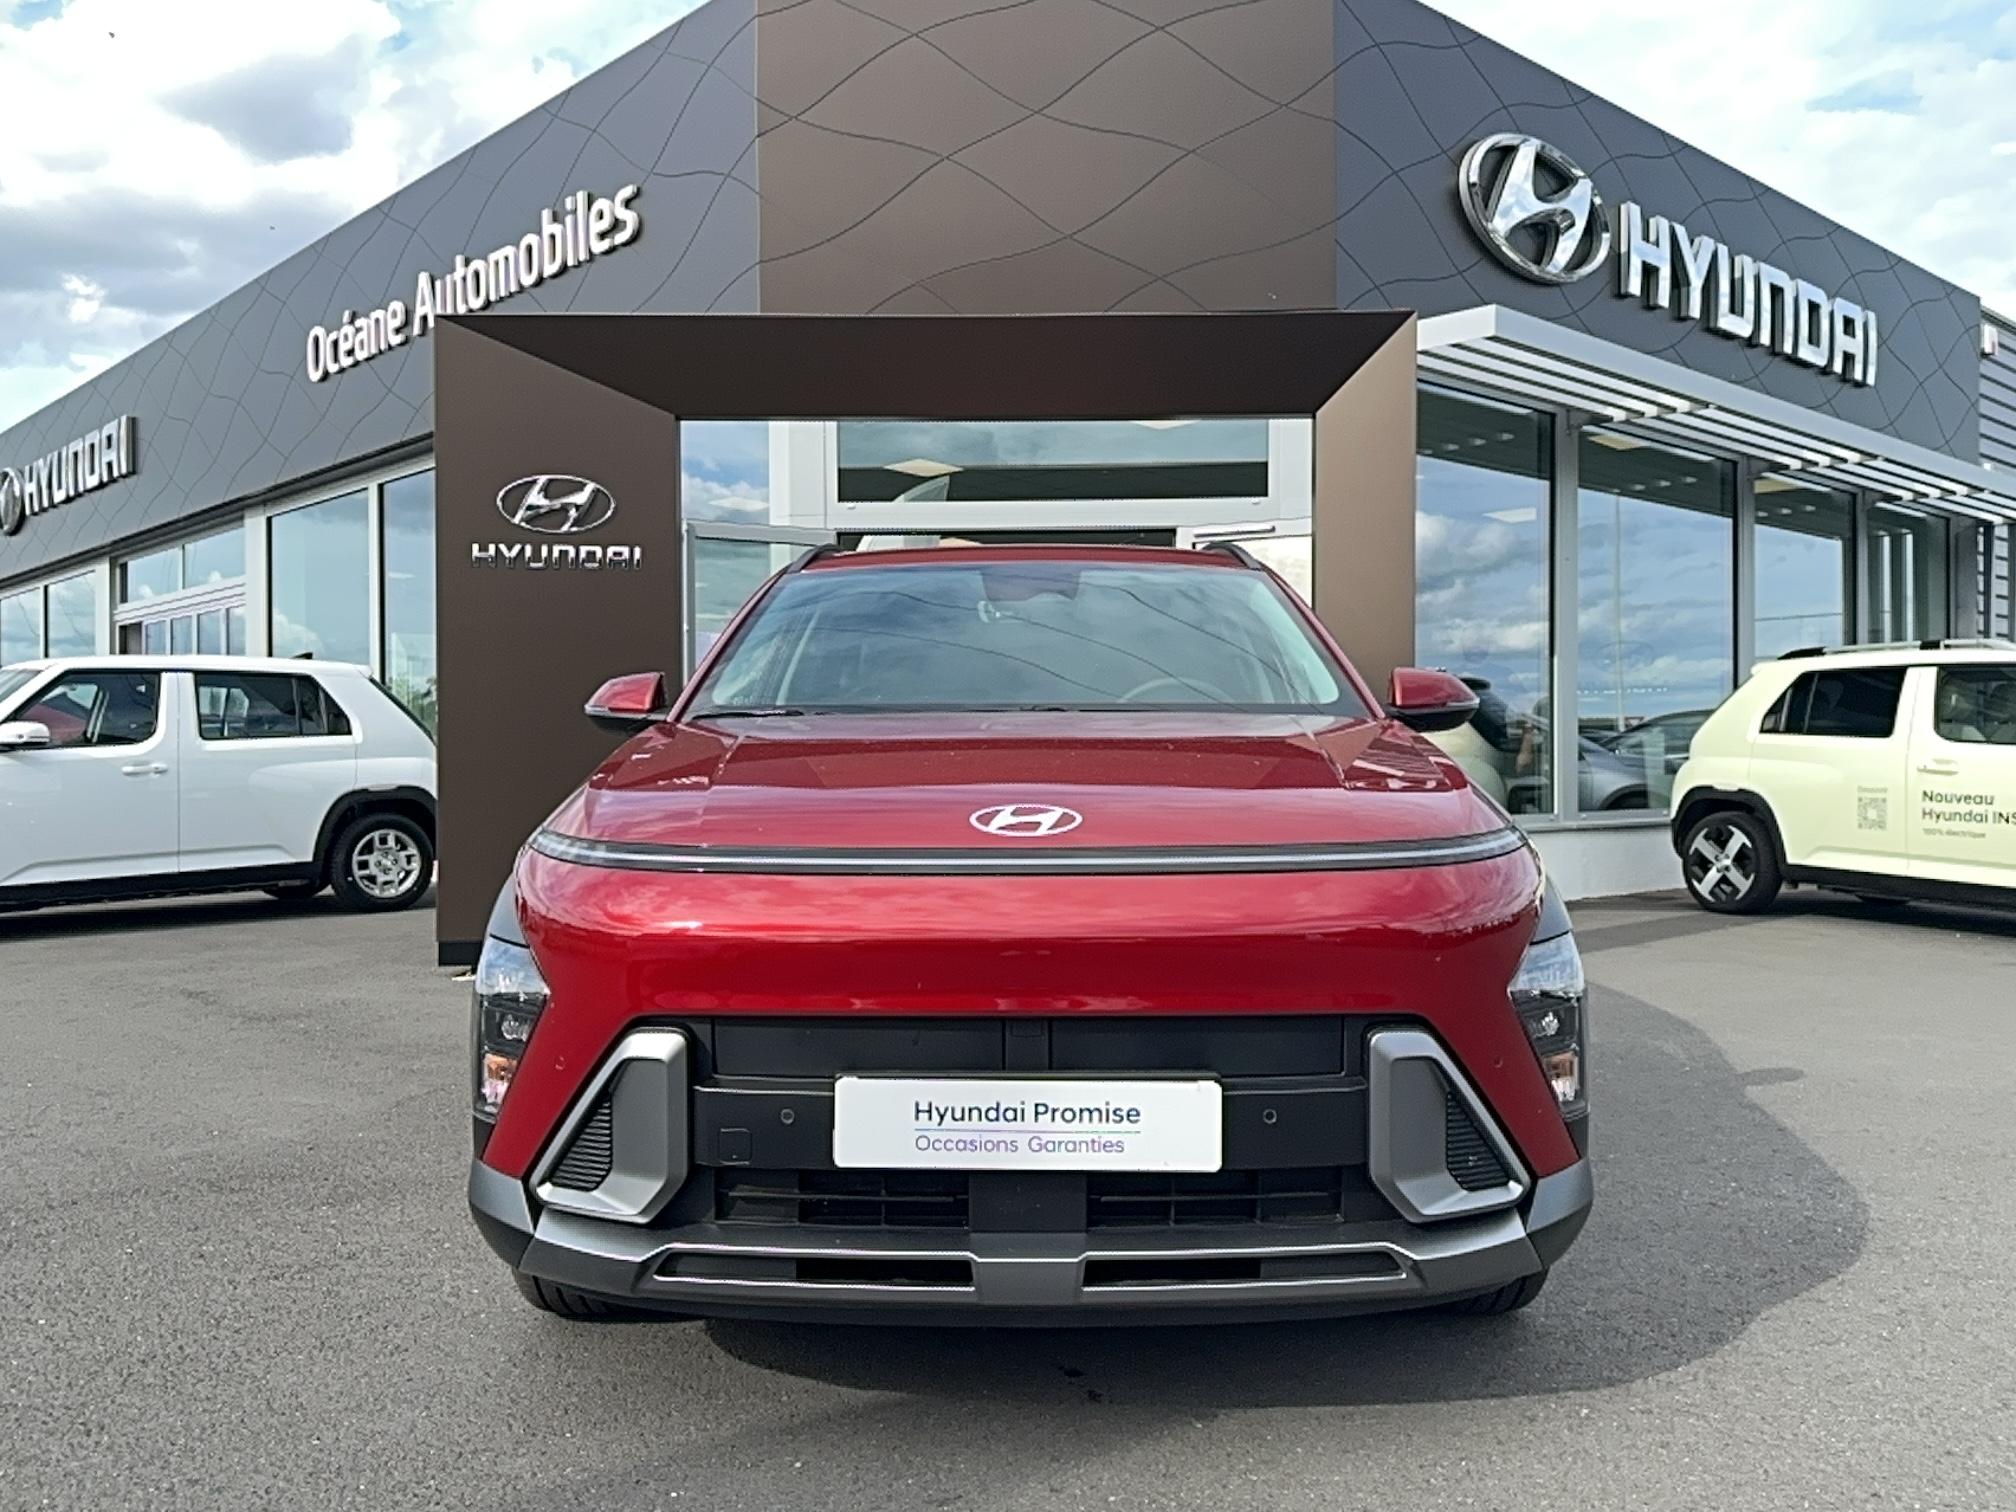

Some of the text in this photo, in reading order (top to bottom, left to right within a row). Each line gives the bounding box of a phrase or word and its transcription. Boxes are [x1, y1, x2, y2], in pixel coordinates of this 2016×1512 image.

[306, 184, 639, 383] Océane Automobiles
[1620, 200, 1878, 387] HYUNDAI
[23, 414, 130, 516] HYUNDAI
[471, 542, 642, 570] HYUNDAI
[1921, 789, 1995, 806] Nouveau
[1921, 808, 1989, 824] Hyundai
[914, 1100, 1142, 1127] Hyundai Promise
[914, 1134, 1126, 1154] Occasions Garanties
